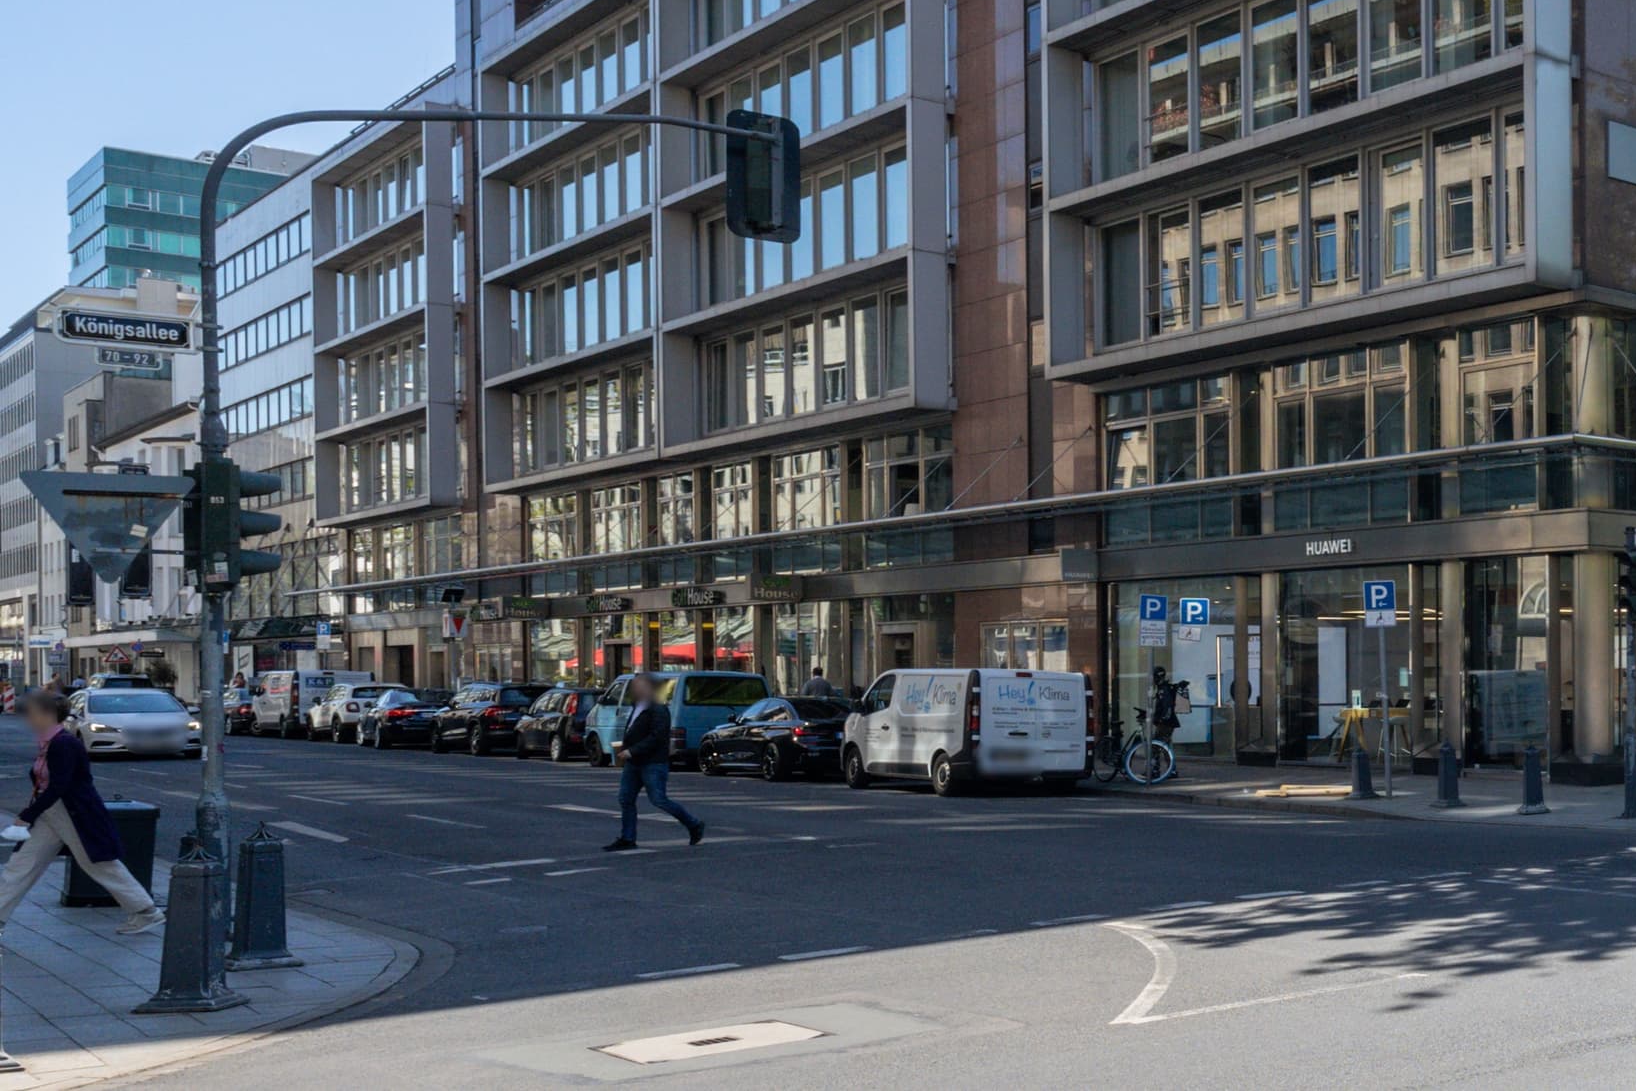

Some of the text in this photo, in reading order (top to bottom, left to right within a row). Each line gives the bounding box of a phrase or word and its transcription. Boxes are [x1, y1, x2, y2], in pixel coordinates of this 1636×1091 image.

[75, 316, 180, 341] Königsallee
[105, 351, 120, 362] 70
[133, 353, 149, 365] 92
[1306, 538, 1352, 556] HUAWEI
[754, 588, 799, 599] House
[1370, 584, 1389, 608] P
[1146, 598, 1161, 619] P
[1186, 601, 1202, 622] P
[933, 685, 957, 705] Klima
[1039, 686, 1071, 701] Klima
